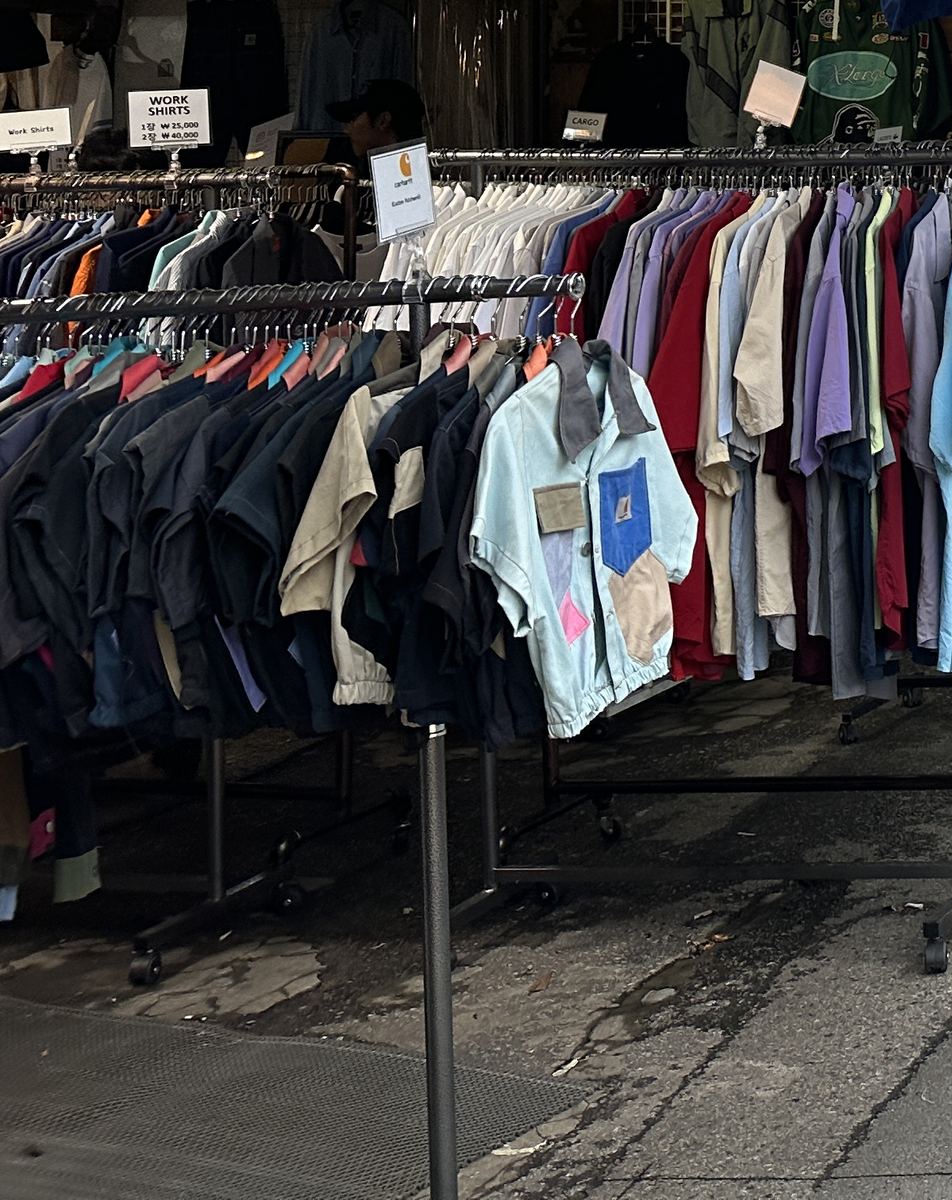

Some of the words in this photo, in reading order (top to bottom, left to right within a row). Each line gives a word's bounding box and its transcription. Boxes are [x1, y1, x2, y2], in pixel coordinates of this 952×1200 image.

[149, 96, 188, 105] WORK
[148, 106, 190, 116] SHIRTS
[572, 117, 599, 126] CARGO
